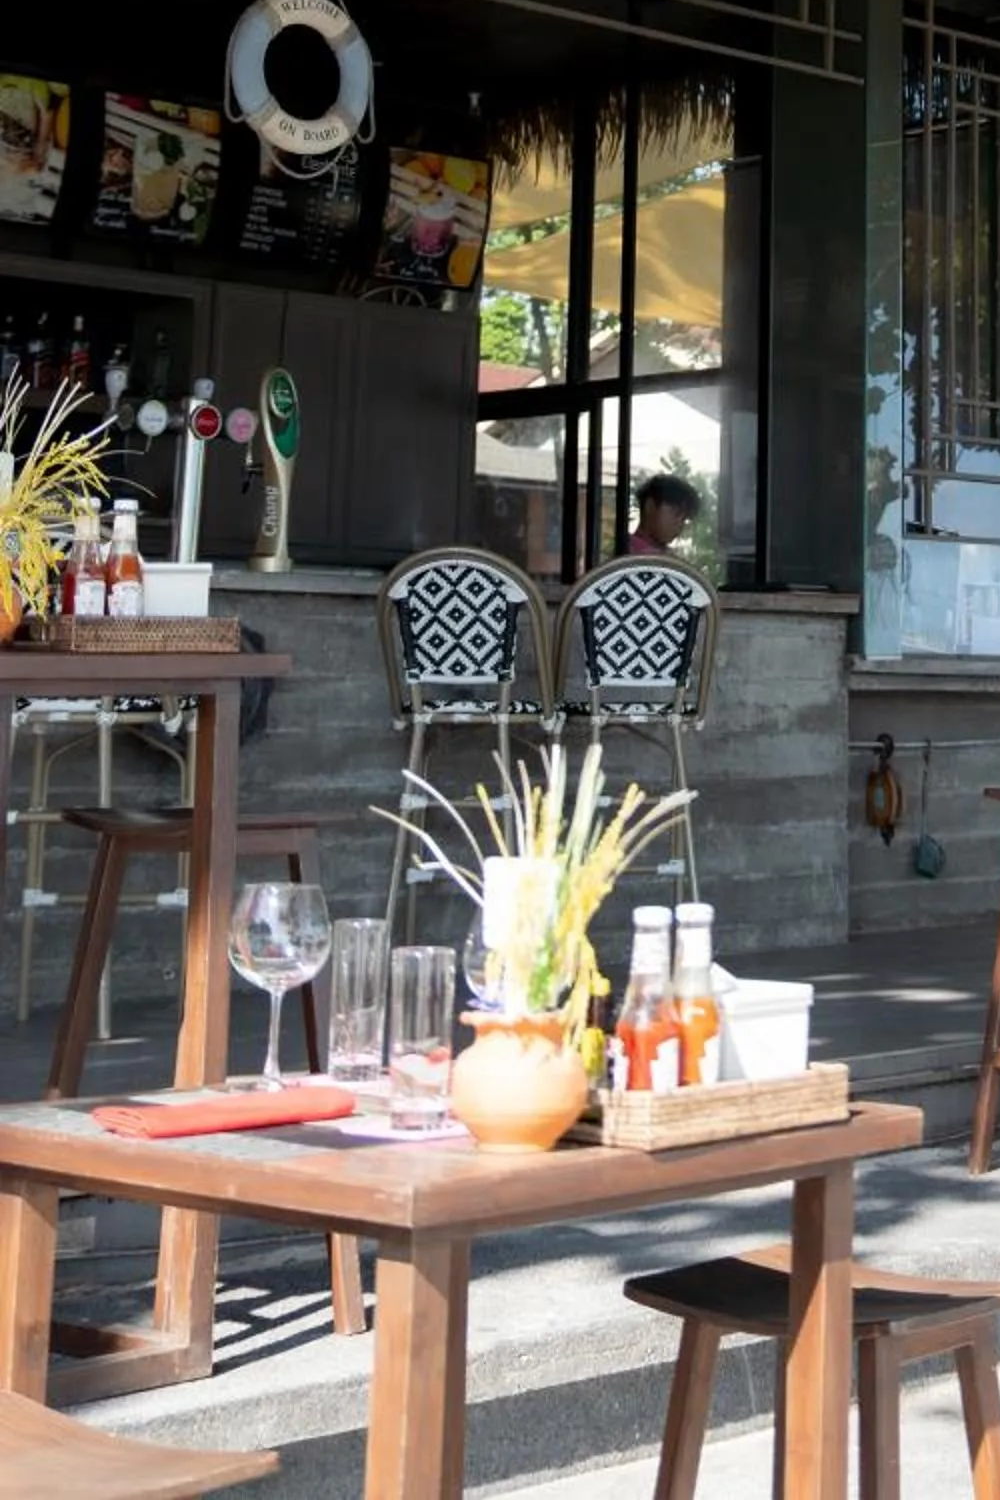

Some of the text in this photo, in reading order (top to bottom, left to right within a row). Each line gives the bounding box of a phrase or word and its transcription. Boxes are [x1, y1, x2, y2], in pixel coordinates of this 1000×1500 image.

[279, 121, 340, 141] ON BOARD
[261, 485, 279, 537] Chang
